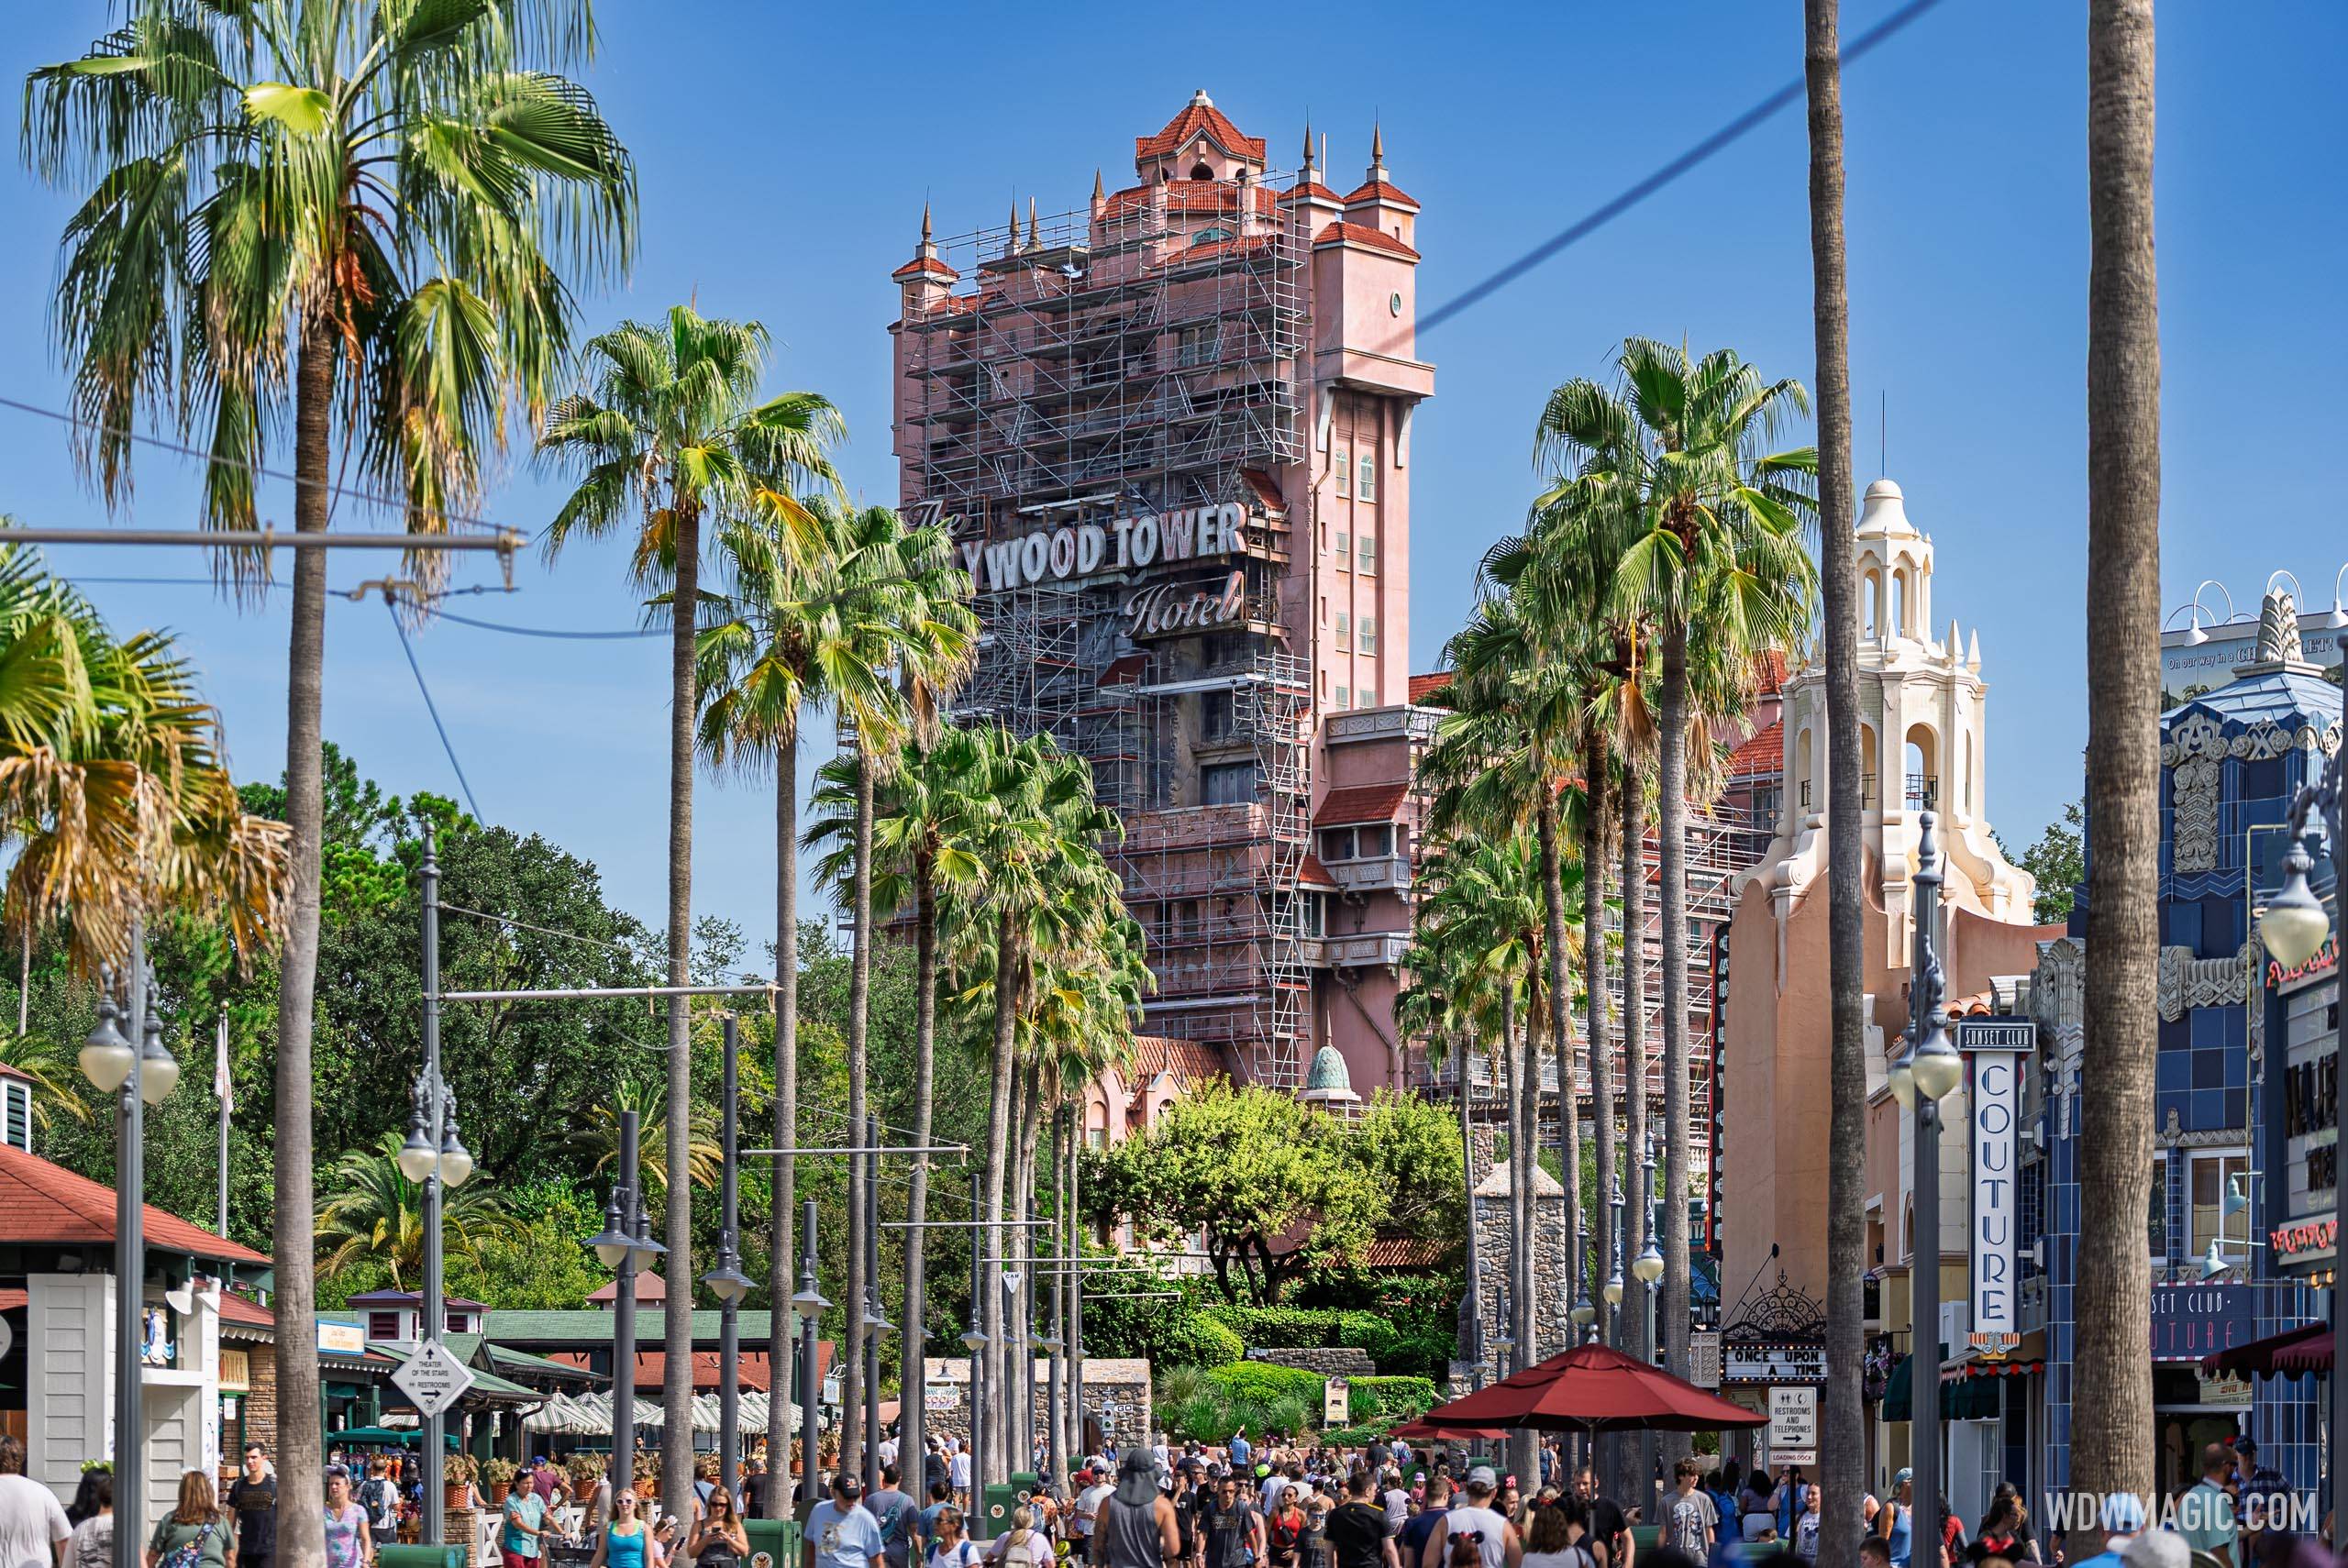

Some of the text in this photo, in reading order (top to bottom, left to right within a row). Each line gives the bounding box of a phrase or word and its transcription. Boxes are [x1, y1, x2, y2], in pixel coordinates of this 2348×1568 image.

[905, 499, 972, 536] The
[957, 502, 1248, 592] YWOOD TOWER
[1118, 570, 1244, 639] Hotel
[2167, 658, 2181, 669] On
[2182, 658, 2198, 668] our
[2198, 657, 2215, 669] way
[2217, 654, 2226, 663] in
[1965, 1030, 2029, 1045] SUNSET CLUB
[1979, 1065, 2010, 1320] COUTURE
[2151, 1292, 2222, 1314] SET CLUB
[2150, 1320, 2233, 1351] UTURE
[1734, 1351, 1820, 1363] ONCE UPON
[1767, 1364, 1822, 1375] A TIME
[1774, 1408, 1811, 1416] RESTROOMS
[1786, 1416, 1800, 1424] AND
[1774, 1425, 1811, 1433] TELEPHONES
